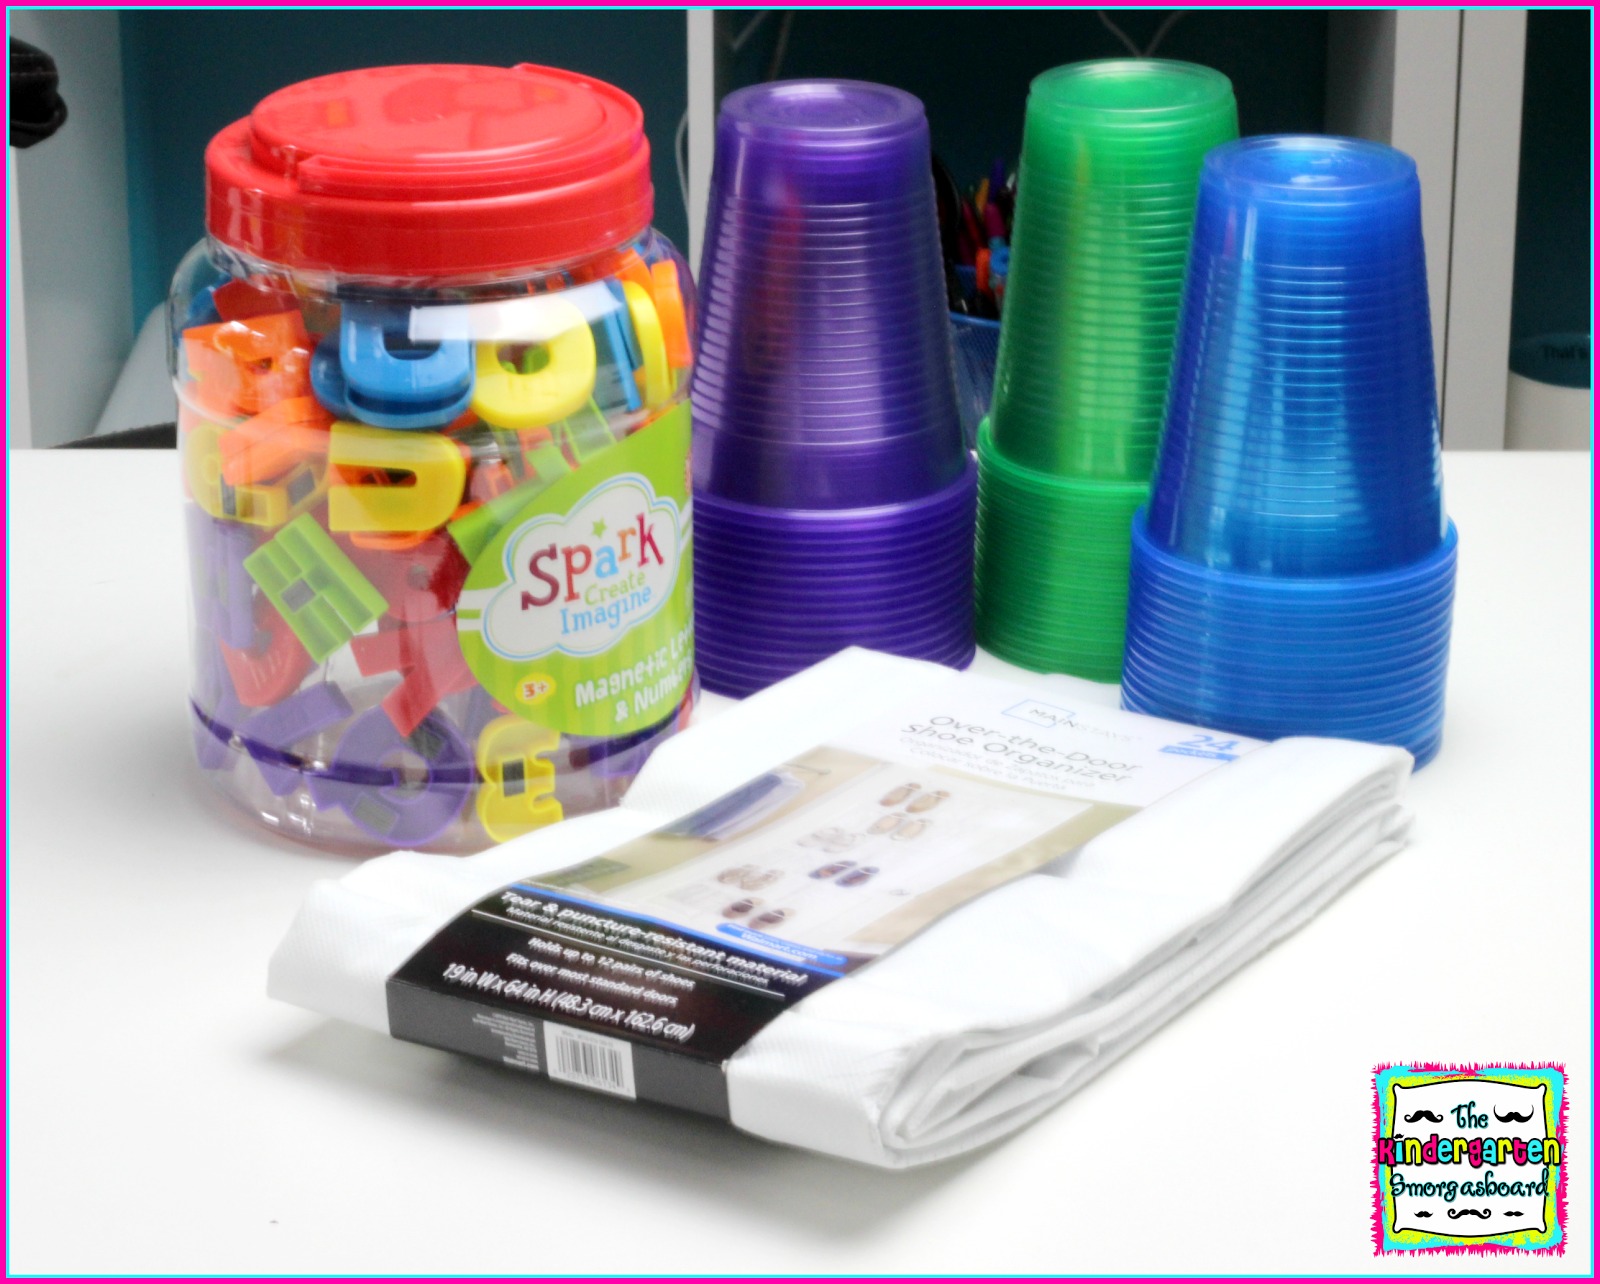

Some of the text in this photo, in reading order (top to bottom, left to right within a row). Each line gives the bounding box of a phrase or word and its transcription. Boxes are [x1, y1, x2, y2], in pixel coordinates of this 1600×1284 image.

[520, 512, 665, 611] Spark
[560, 585, 652, 635] Imagine
[584, 570, 646, 606] Create
[523, 681, 549, 698] 3+
[575, 646, 667, 708] Magnetic
[616, 700, 628, 722] &
[929, 715, 1143, 772] Over-the-Door
[983, 741, 1133, 783] Organizer
[1176, 733, 1241, 751] 24
[501, 891, 543, 909] Tear
[542, 903, 559, 916] &
[557, 908, 726, 963] puncture-resistant
[726, 955, 809, 987] material
[505, 906, 552, 926] Material
[527, 936, 697, 990] Holds up to 12 pairs of shoes
[741, 931, 818, 961] Walmart.com
[442, 963, 696, 1043] 19 in W x 64 in H (48.3 cm x 162.6 cm)
[505, 952, 680, 1006] Fits over most standard doors
